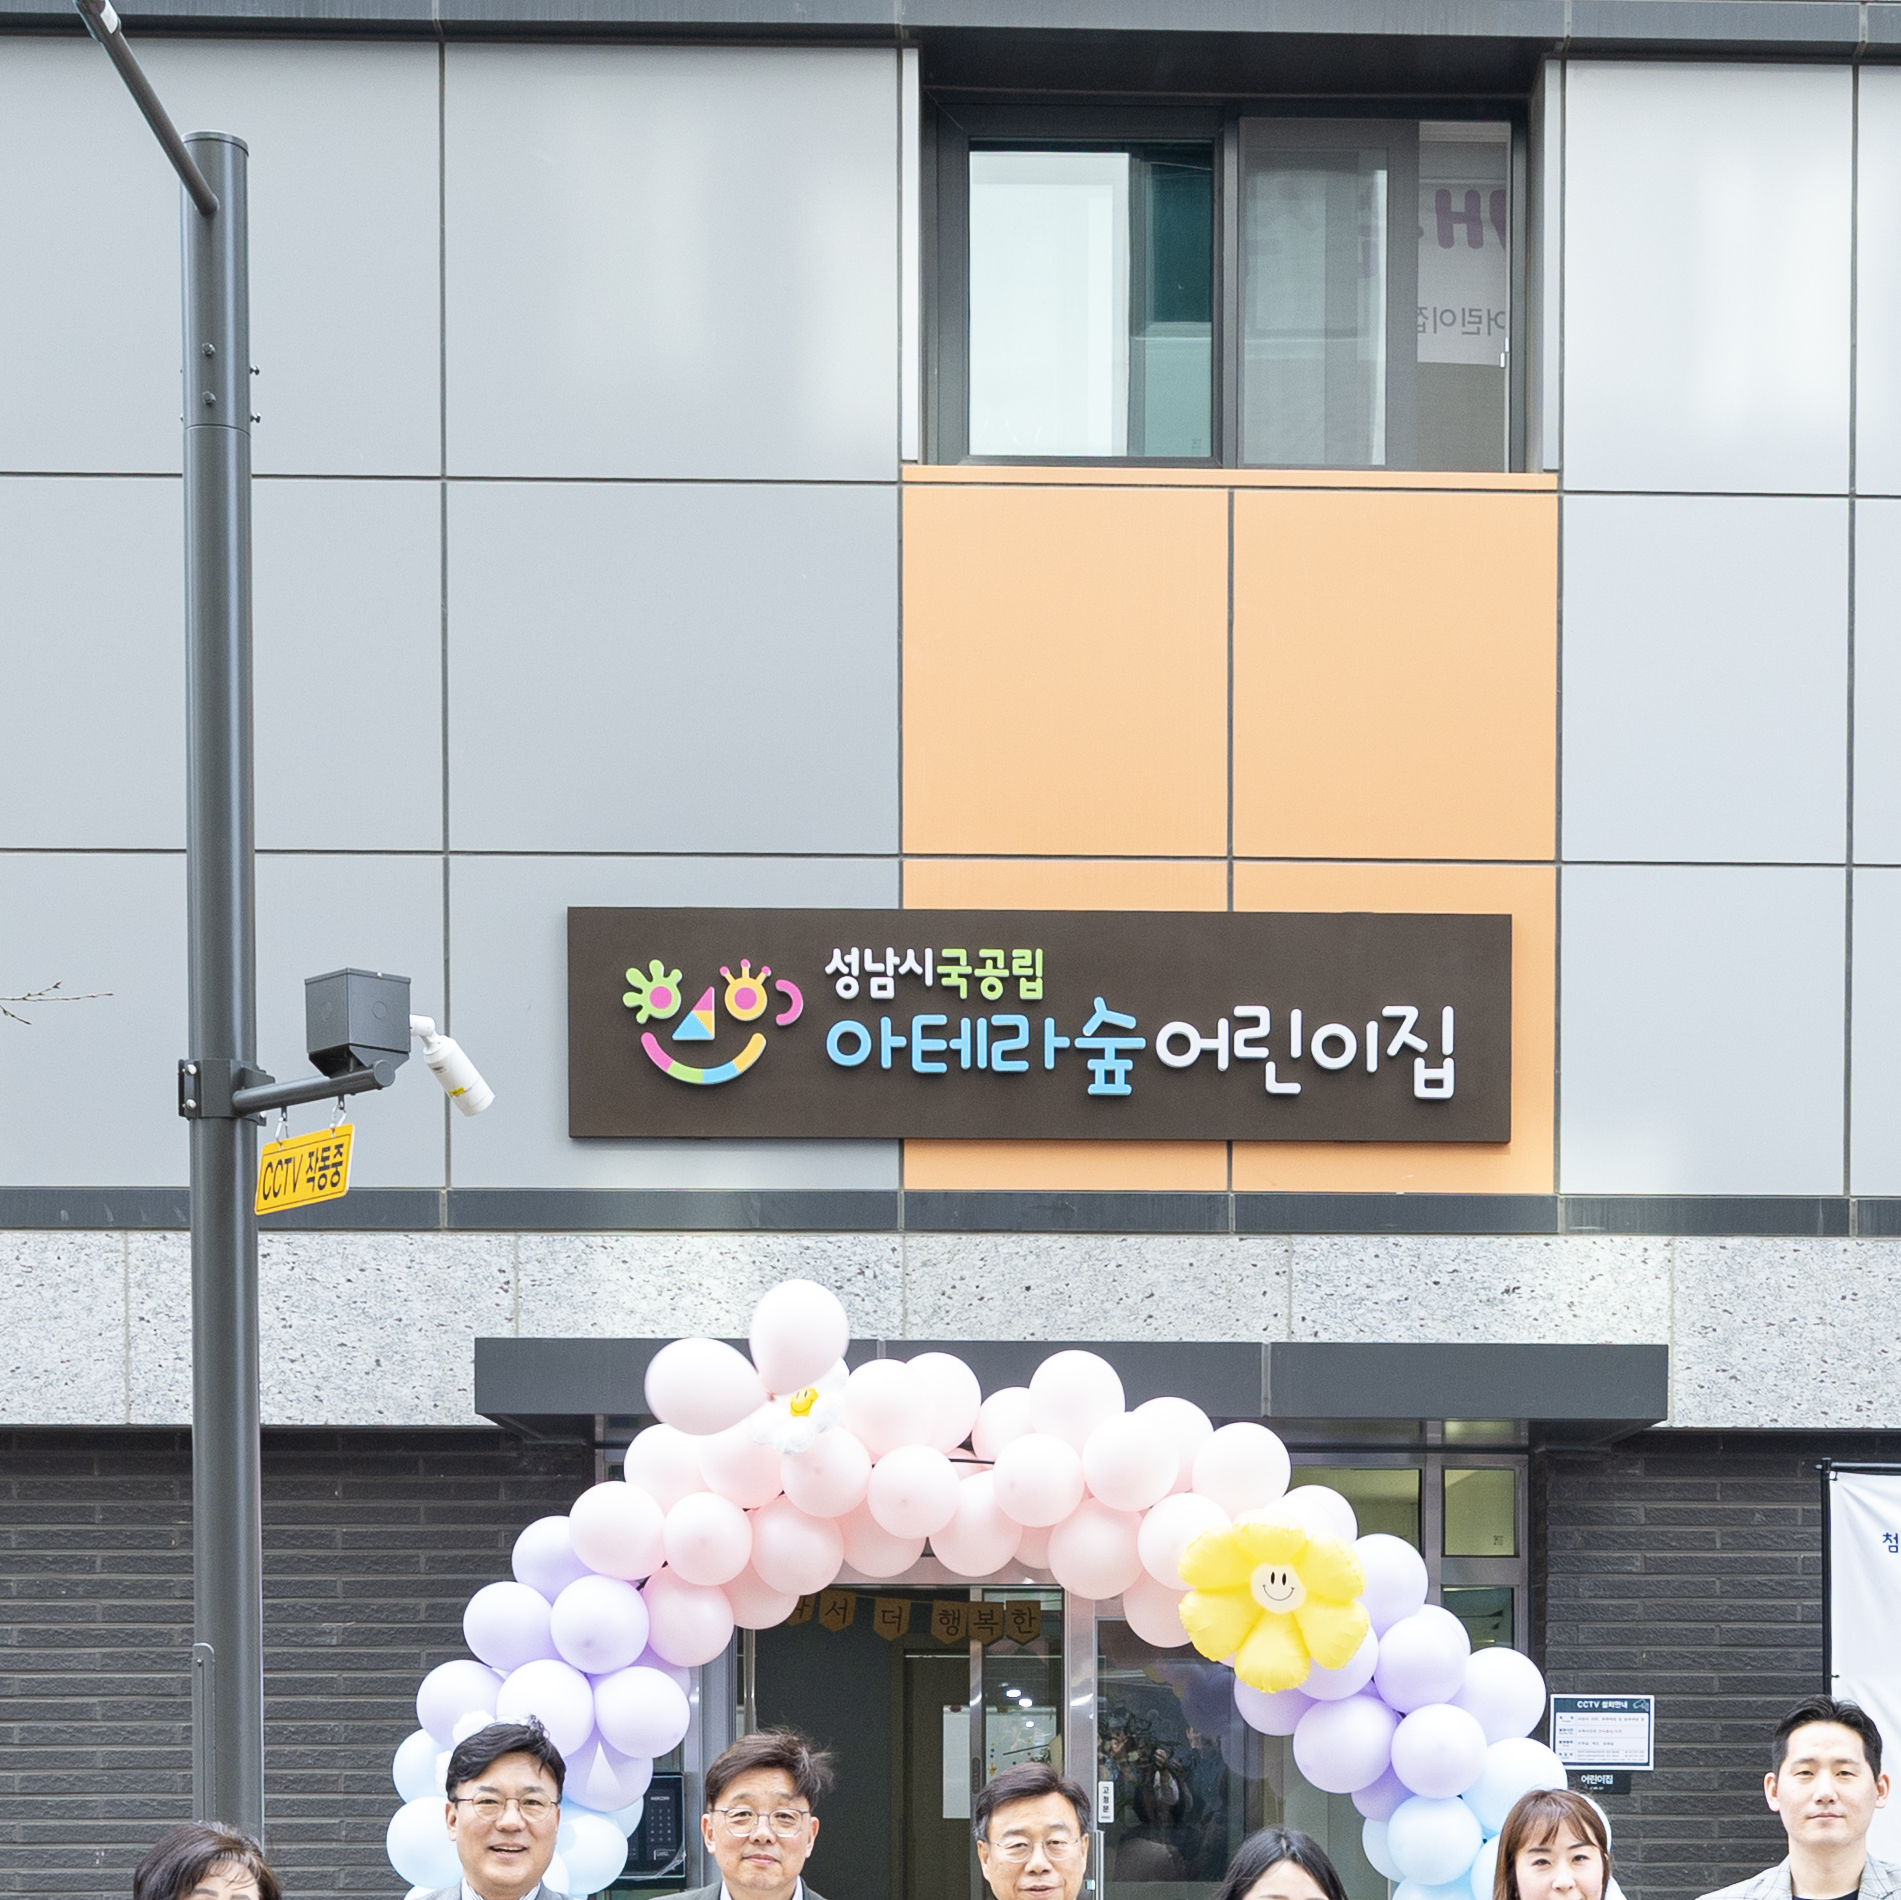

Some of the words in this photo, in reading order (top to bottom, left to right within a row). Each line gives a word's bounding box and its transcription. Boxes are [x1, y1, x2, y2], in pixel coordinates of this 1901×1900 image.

[824, 946, 1045, 1001] 성남시국공립
[262, 1154, 304, 1201] CCTV
[306, 1143, 344, 1193] 작동중
[881, 1606, 903, 1633] 더
[938, 1607, 1037, 1637] 행복한
[1576, 1700, 1600, 1709] CCTV
[1581, 1774, 1613, 1785] 어린이집
